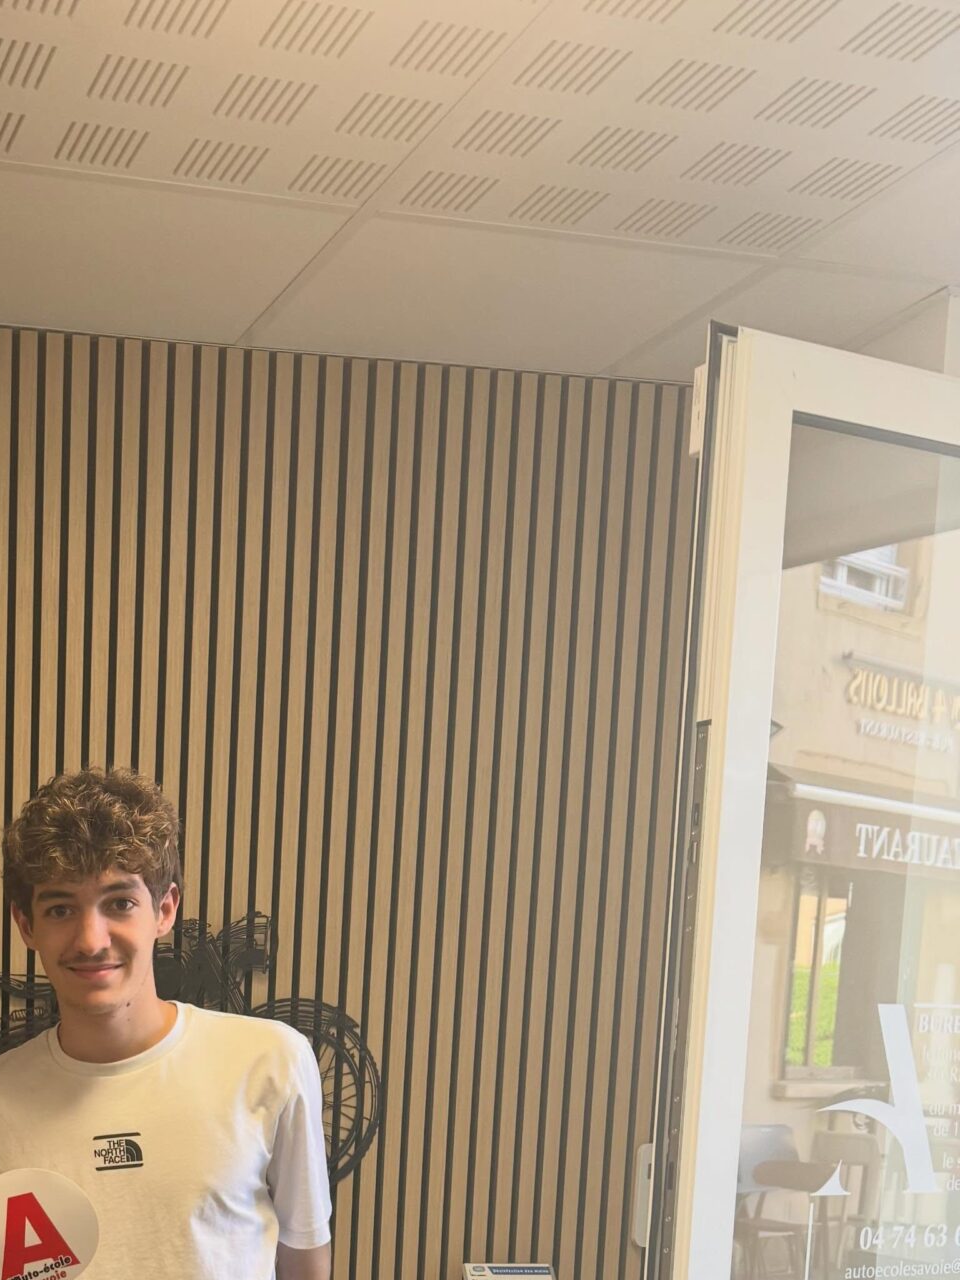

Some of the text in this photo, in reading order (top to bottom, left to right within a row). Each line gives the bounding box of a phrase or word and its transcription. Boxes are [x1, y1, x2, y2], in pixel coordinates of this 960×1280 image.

[107, 1139, 124, 1149] THE
[94, 1147, 125, 1158] NORTH
[103, 1155, 126, 1165] FACE
[1, 1192, 81, 1280] A
[860, 1225, 884, 1250] 04
[892, 1225, 916, 1249] 74
[924, 1223, 947, 1248] 63
